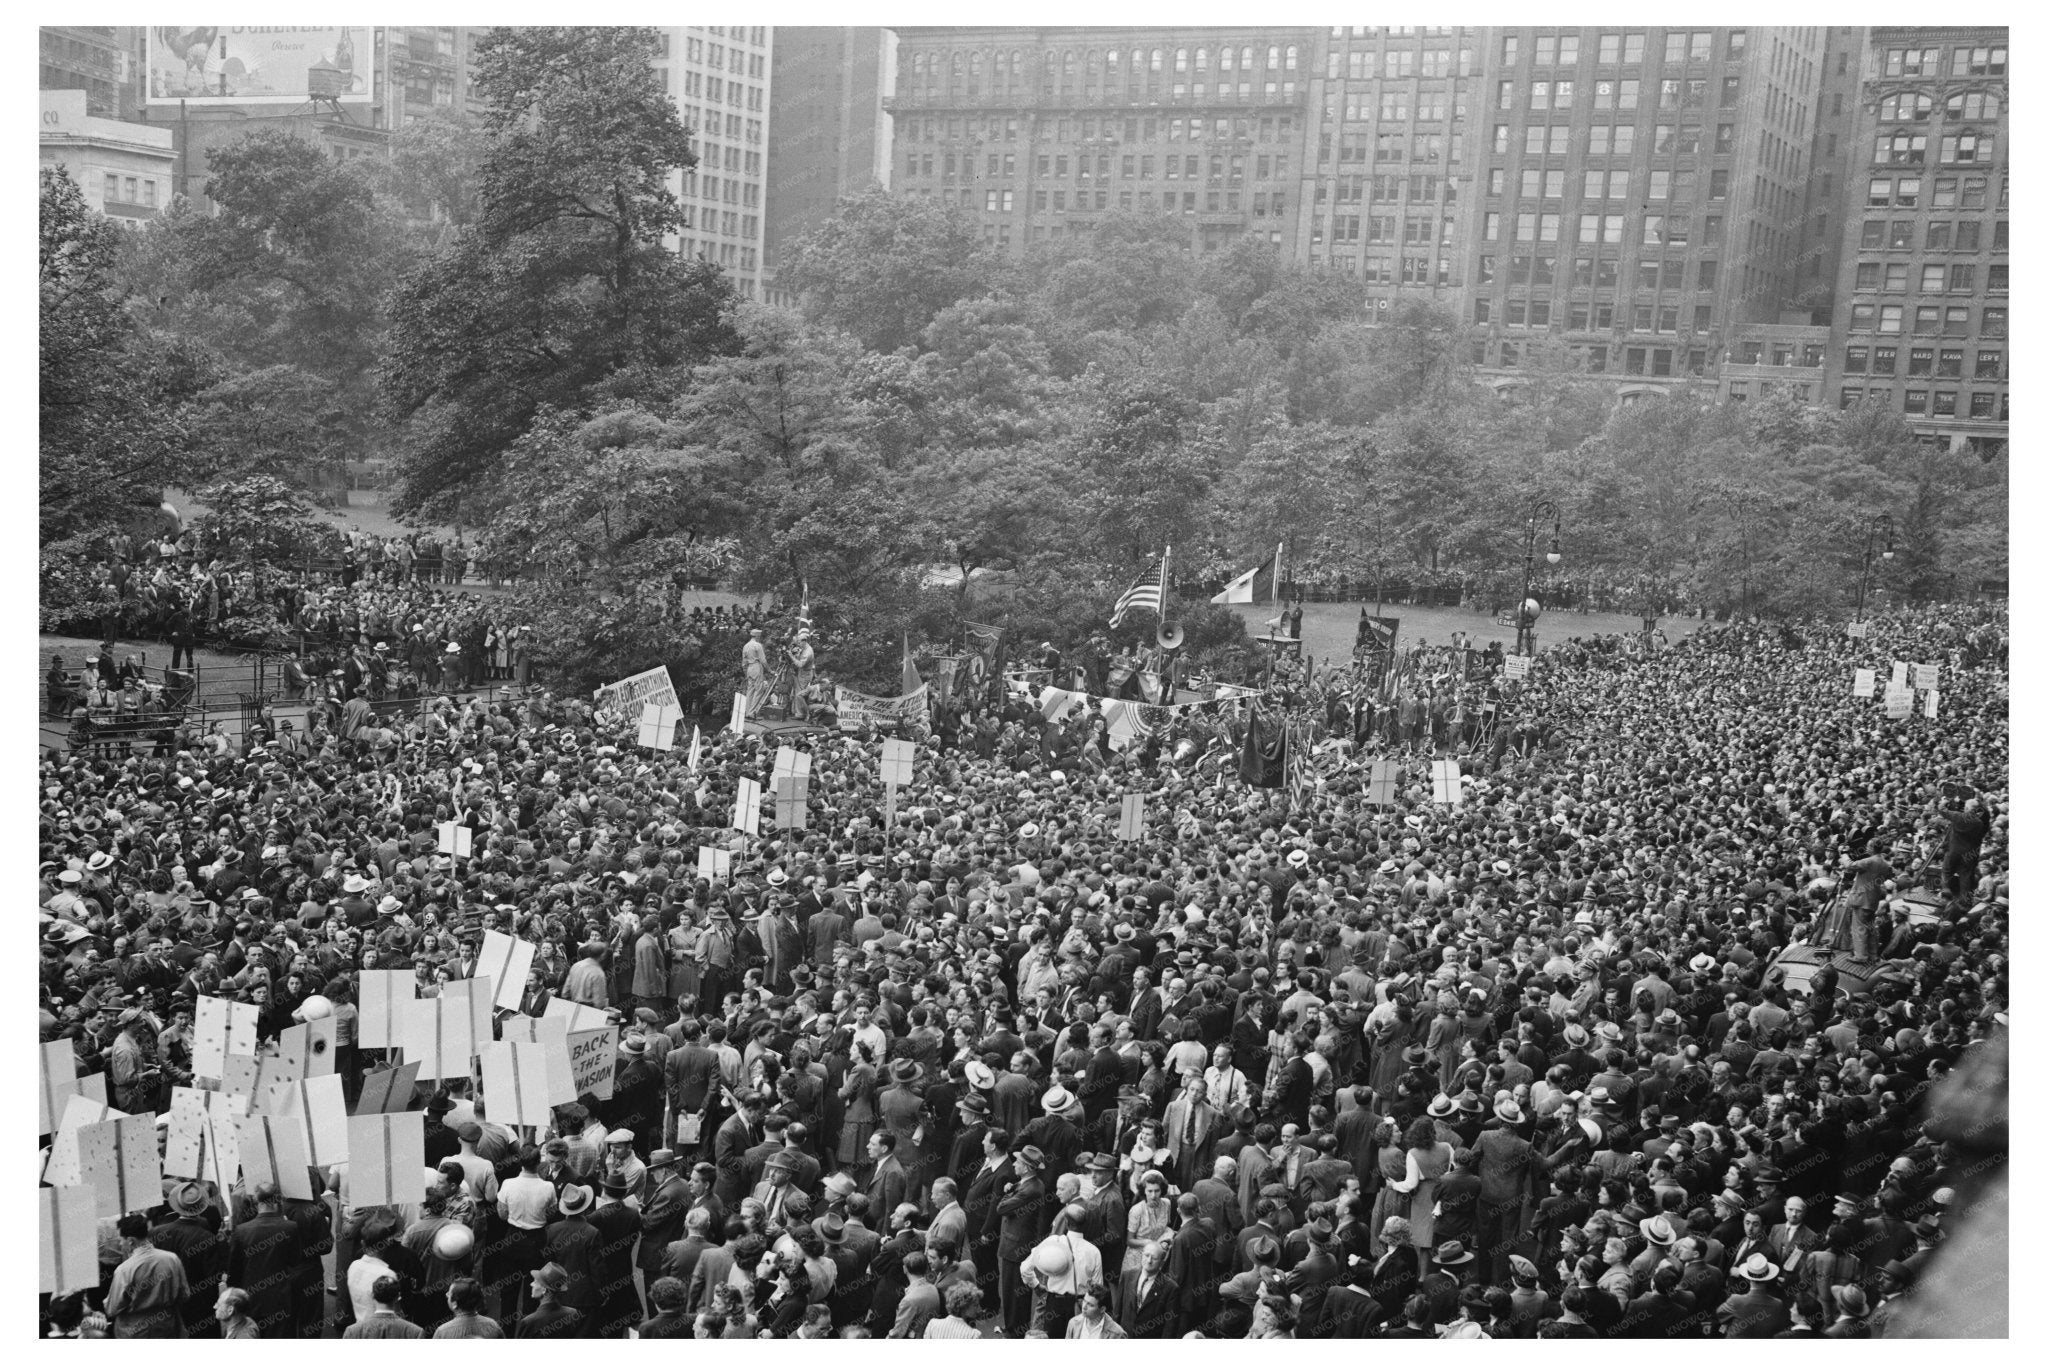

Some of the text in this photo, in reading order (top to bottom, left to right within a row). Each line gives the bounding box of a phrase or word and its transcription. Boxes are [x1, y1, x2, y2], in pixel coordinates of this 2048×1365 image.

[841, 691, 869, 703] BACK
[873, 700, 895, 709] THE
[572, 1032, 609, 1060] BACK
